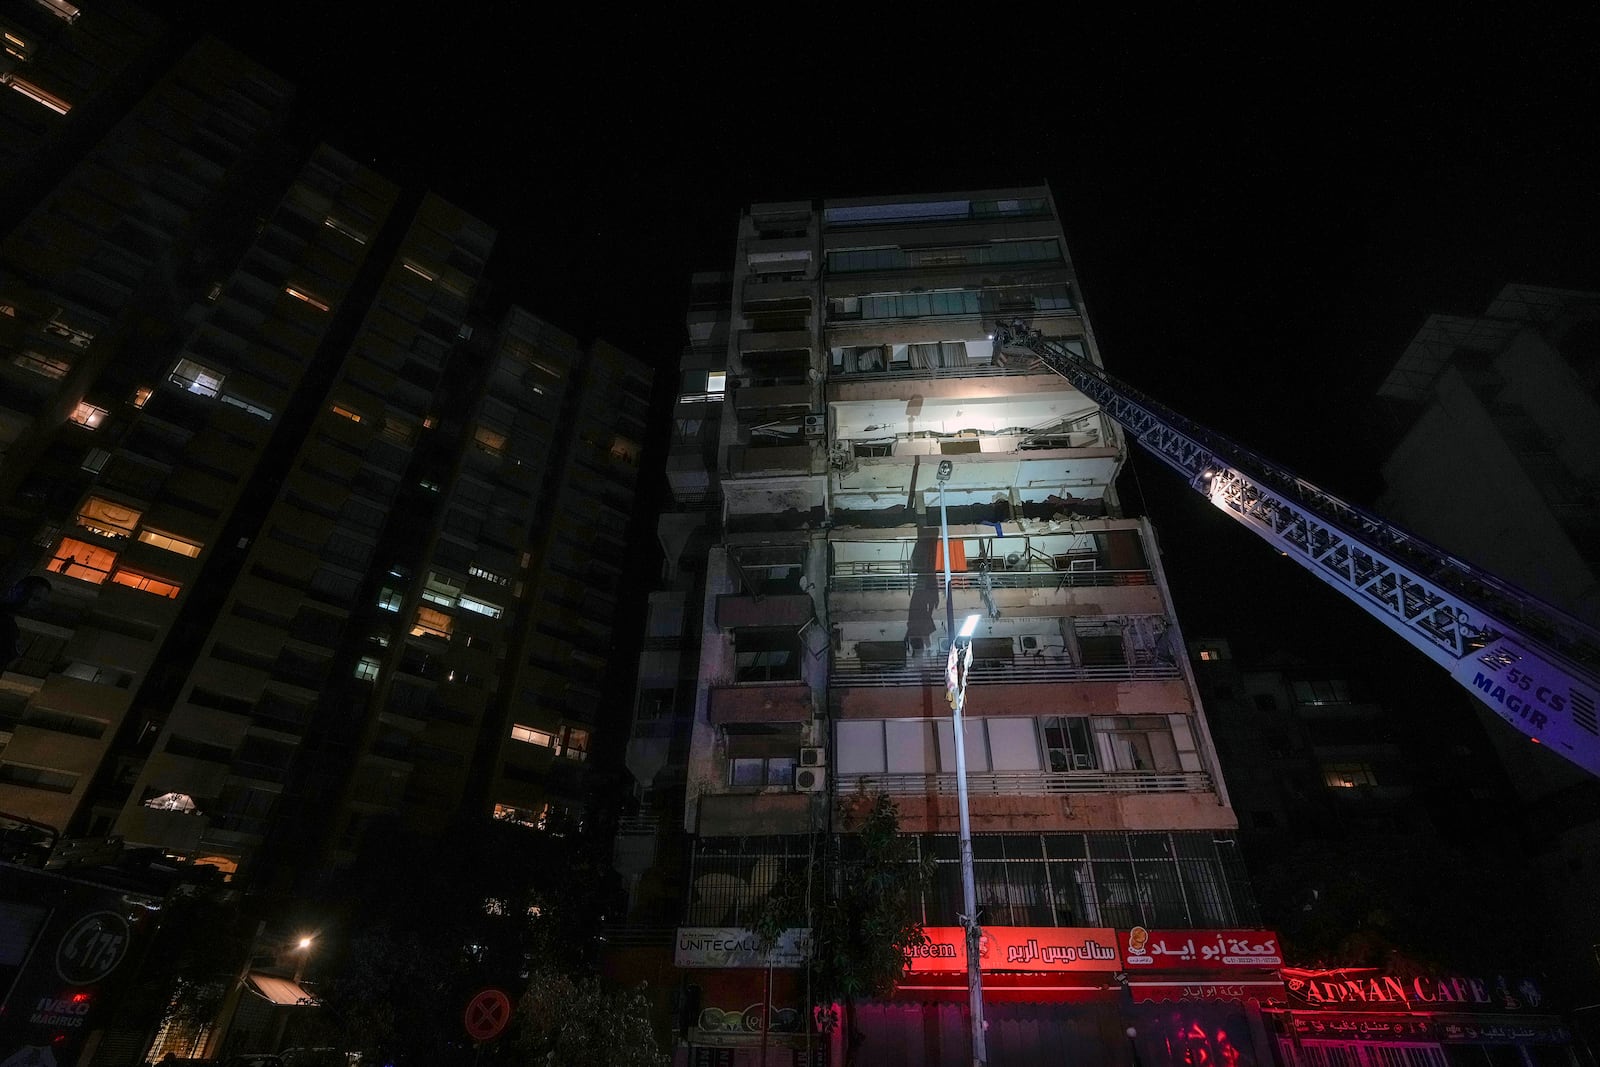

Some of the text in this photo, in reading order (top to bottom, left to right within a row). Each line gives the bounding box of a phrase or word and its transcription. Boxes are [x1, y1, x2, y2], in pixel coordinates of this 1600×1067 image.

[1473, 672, 1549, 731] MAGIR
[1506, 669, 1568, 712] 55 CS
[80, 932, 123, 970] 175
[1008, 940, 1116, 963] سناك ميس الريم
[1201, 934, 1227, 960] أبو
[1227, 939, 1276, 955] كعكة
[1306, 976, 1492, 1009] ADNAN CAFE
